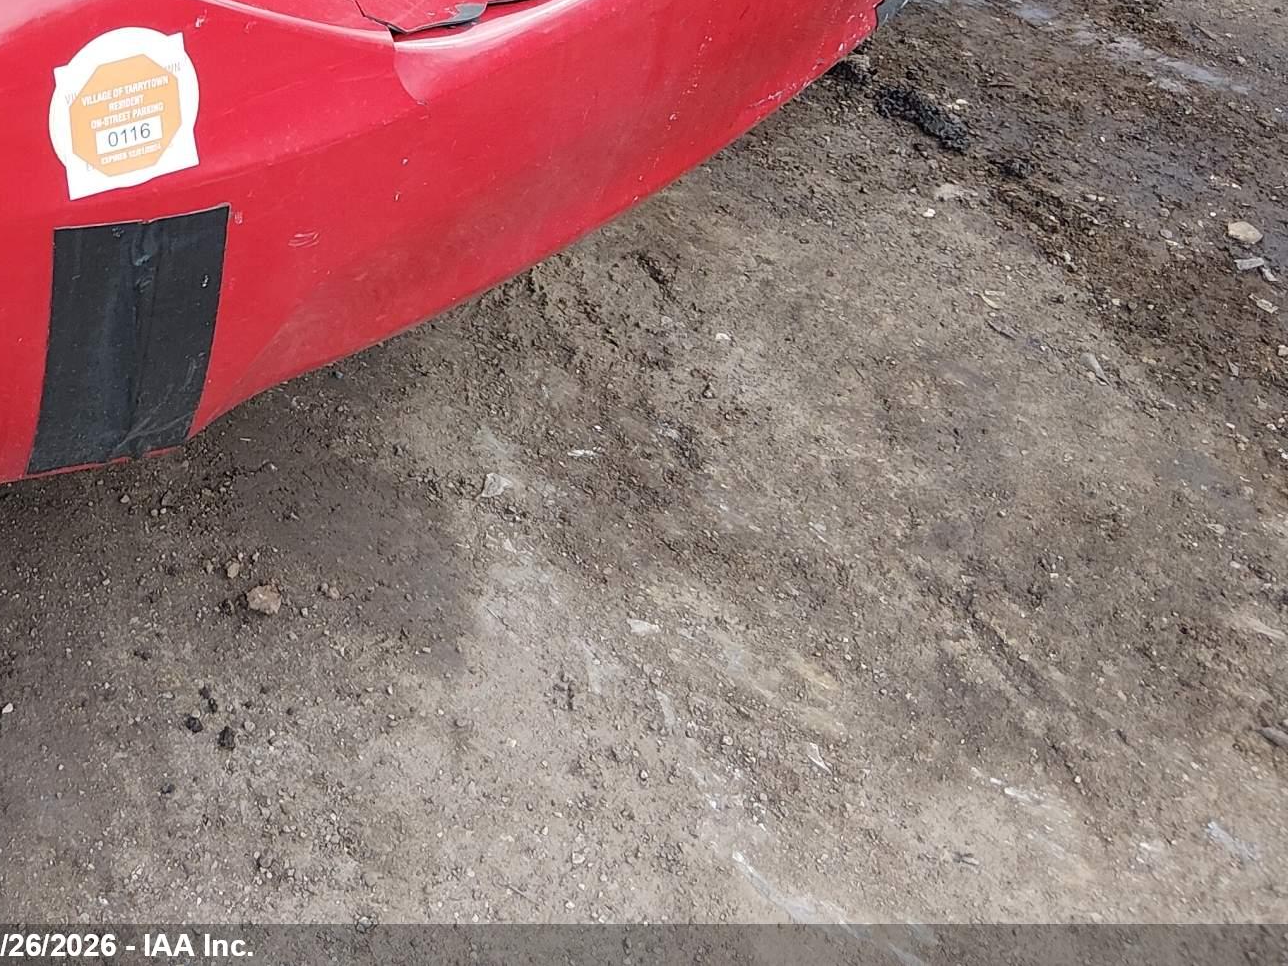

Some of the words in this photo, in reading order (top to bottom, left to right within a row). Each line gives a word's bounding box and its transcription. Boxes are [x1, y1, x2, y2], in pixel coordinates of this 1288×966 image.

[82, 91, 113, 107] VILLAGE
[113, 86, 125, 98] OF
[125, 76, 169, 94] TARRYTOWN
[108, 94, 144, 111] RESIDENT
[90, 112, 132, 129] ON-STREET
[131, 102, 164, 119] PARKING
[108, 122, 151, 147] 0116
